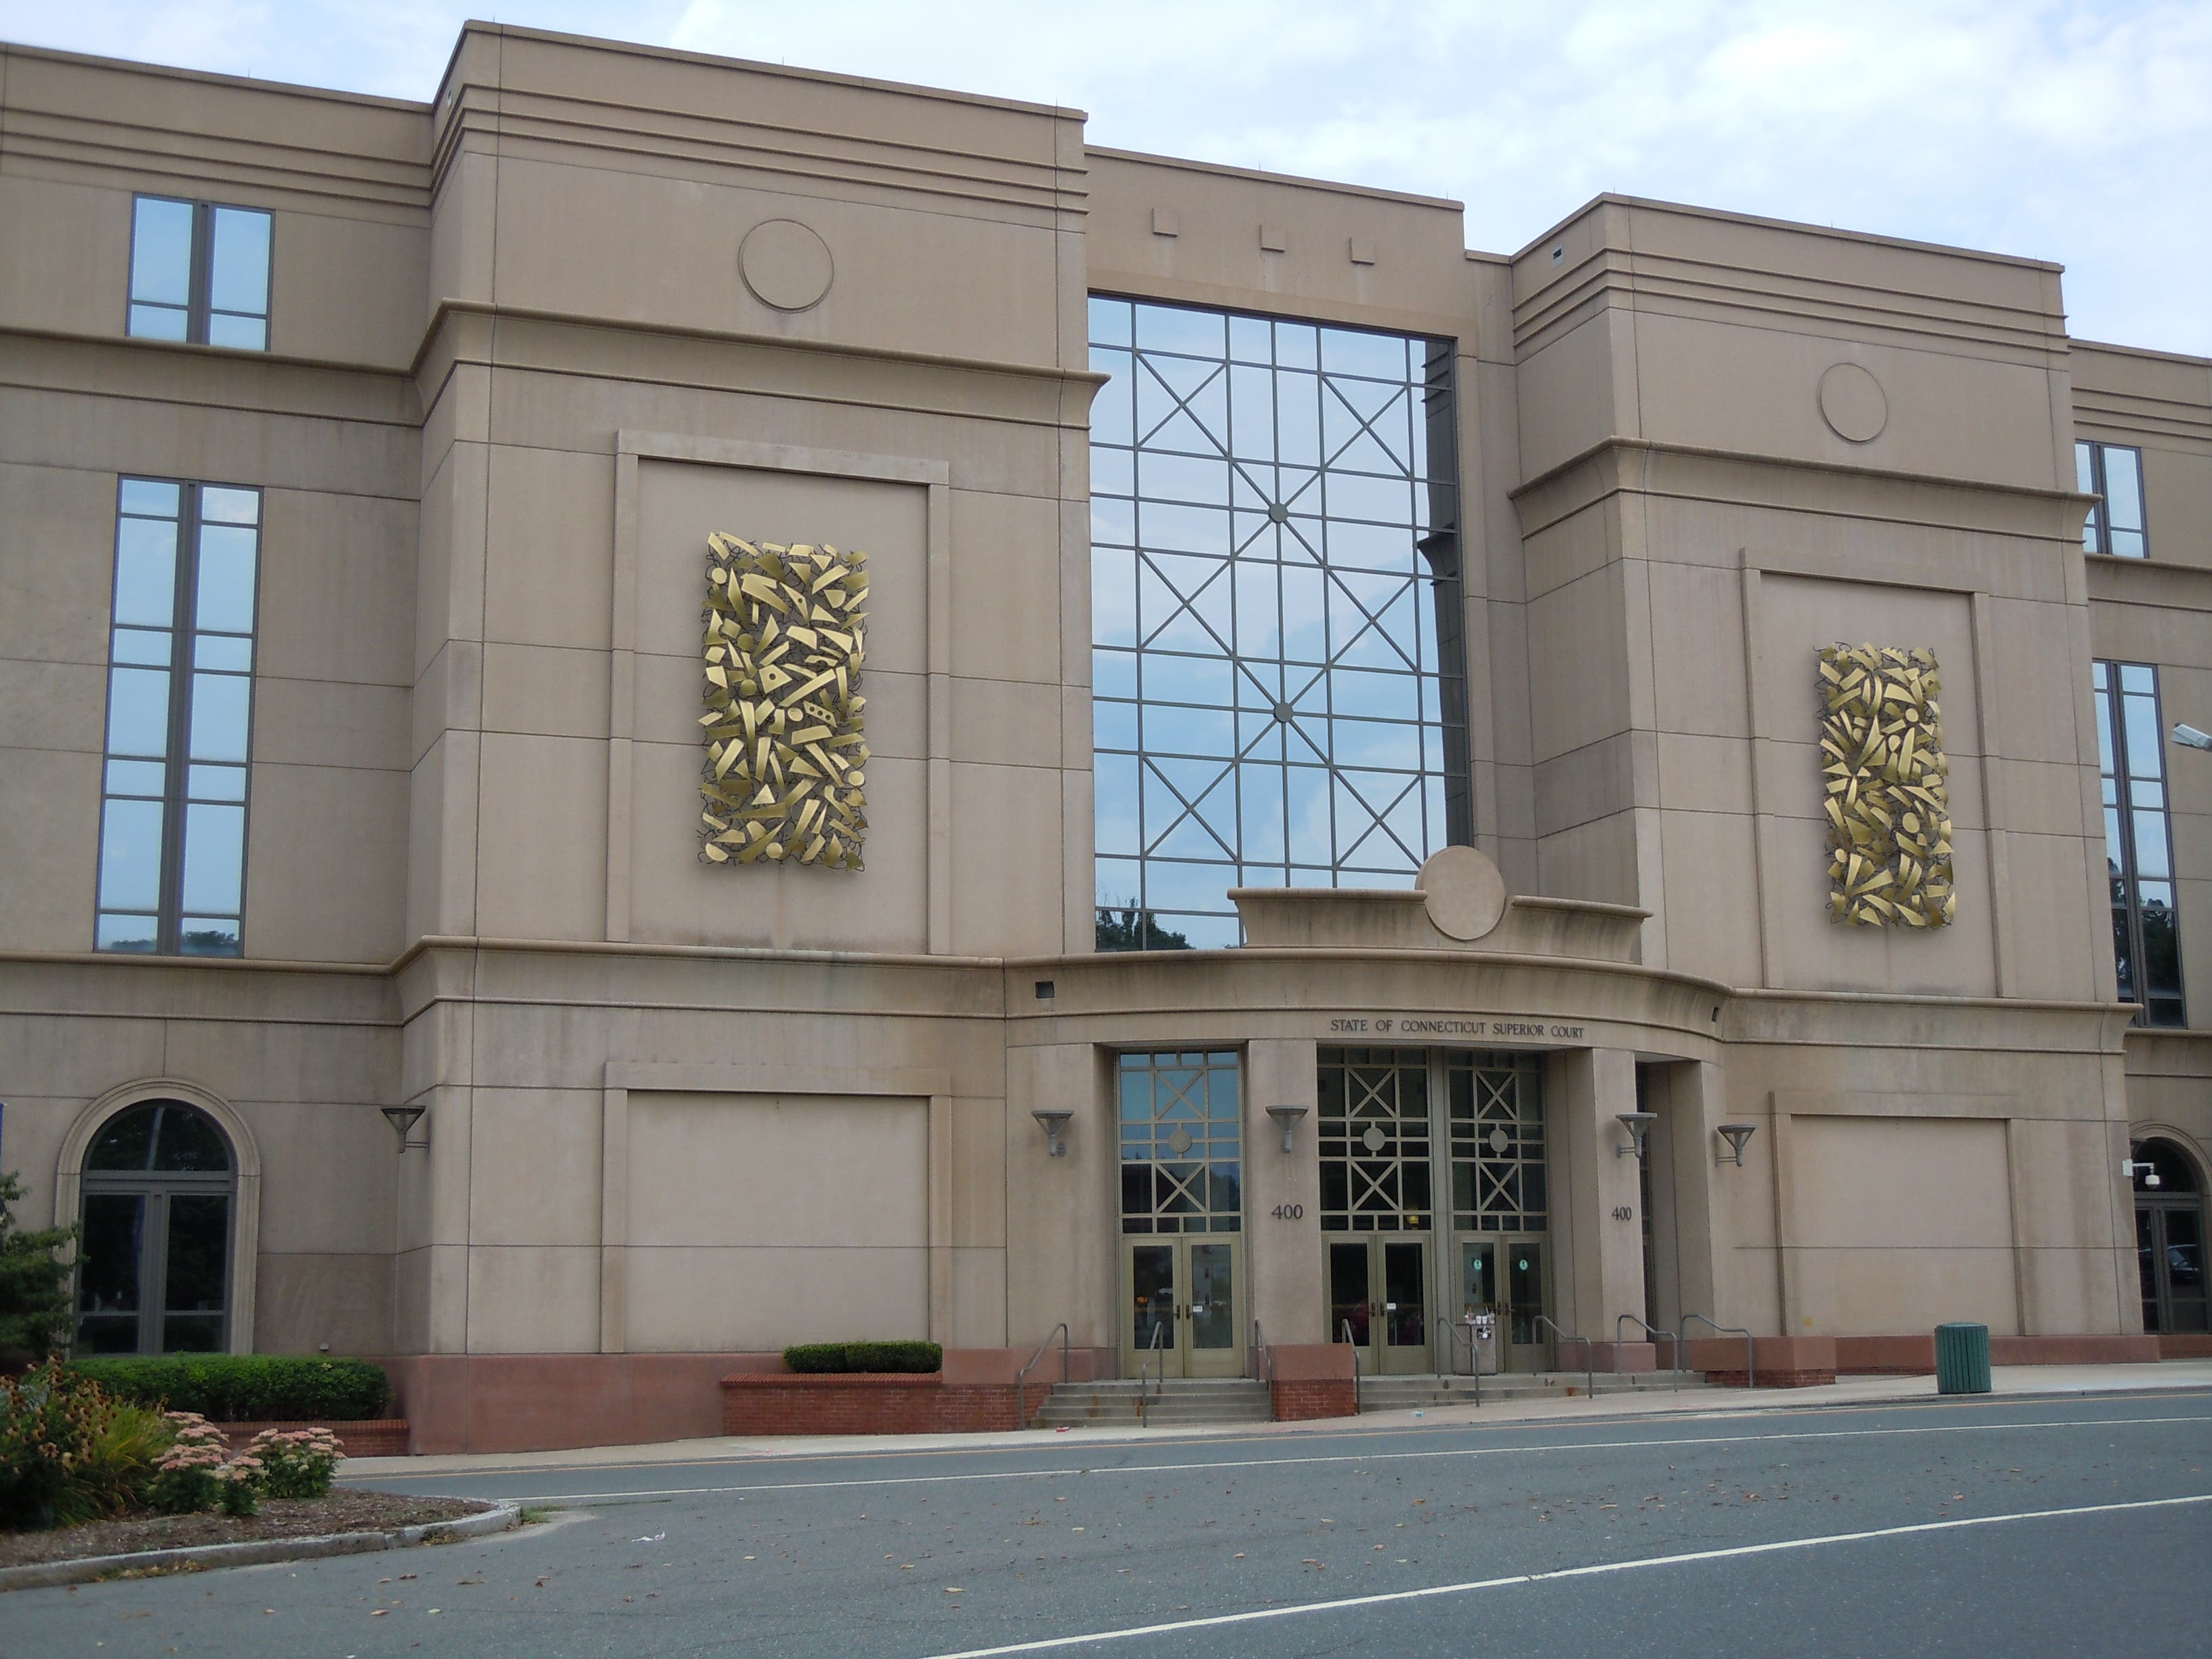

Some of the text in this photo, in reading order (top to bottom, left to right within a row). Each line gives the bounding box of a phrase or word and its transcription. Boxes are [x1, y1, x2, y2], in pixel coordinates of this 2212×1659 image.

[1330, 1019, 1584, 1038] STATE OF CONNECTICUT SUPERIOR COURT
[1271, 1204, 1303, 1219] 400
[1612, 1206, 1632, 1221] 400
